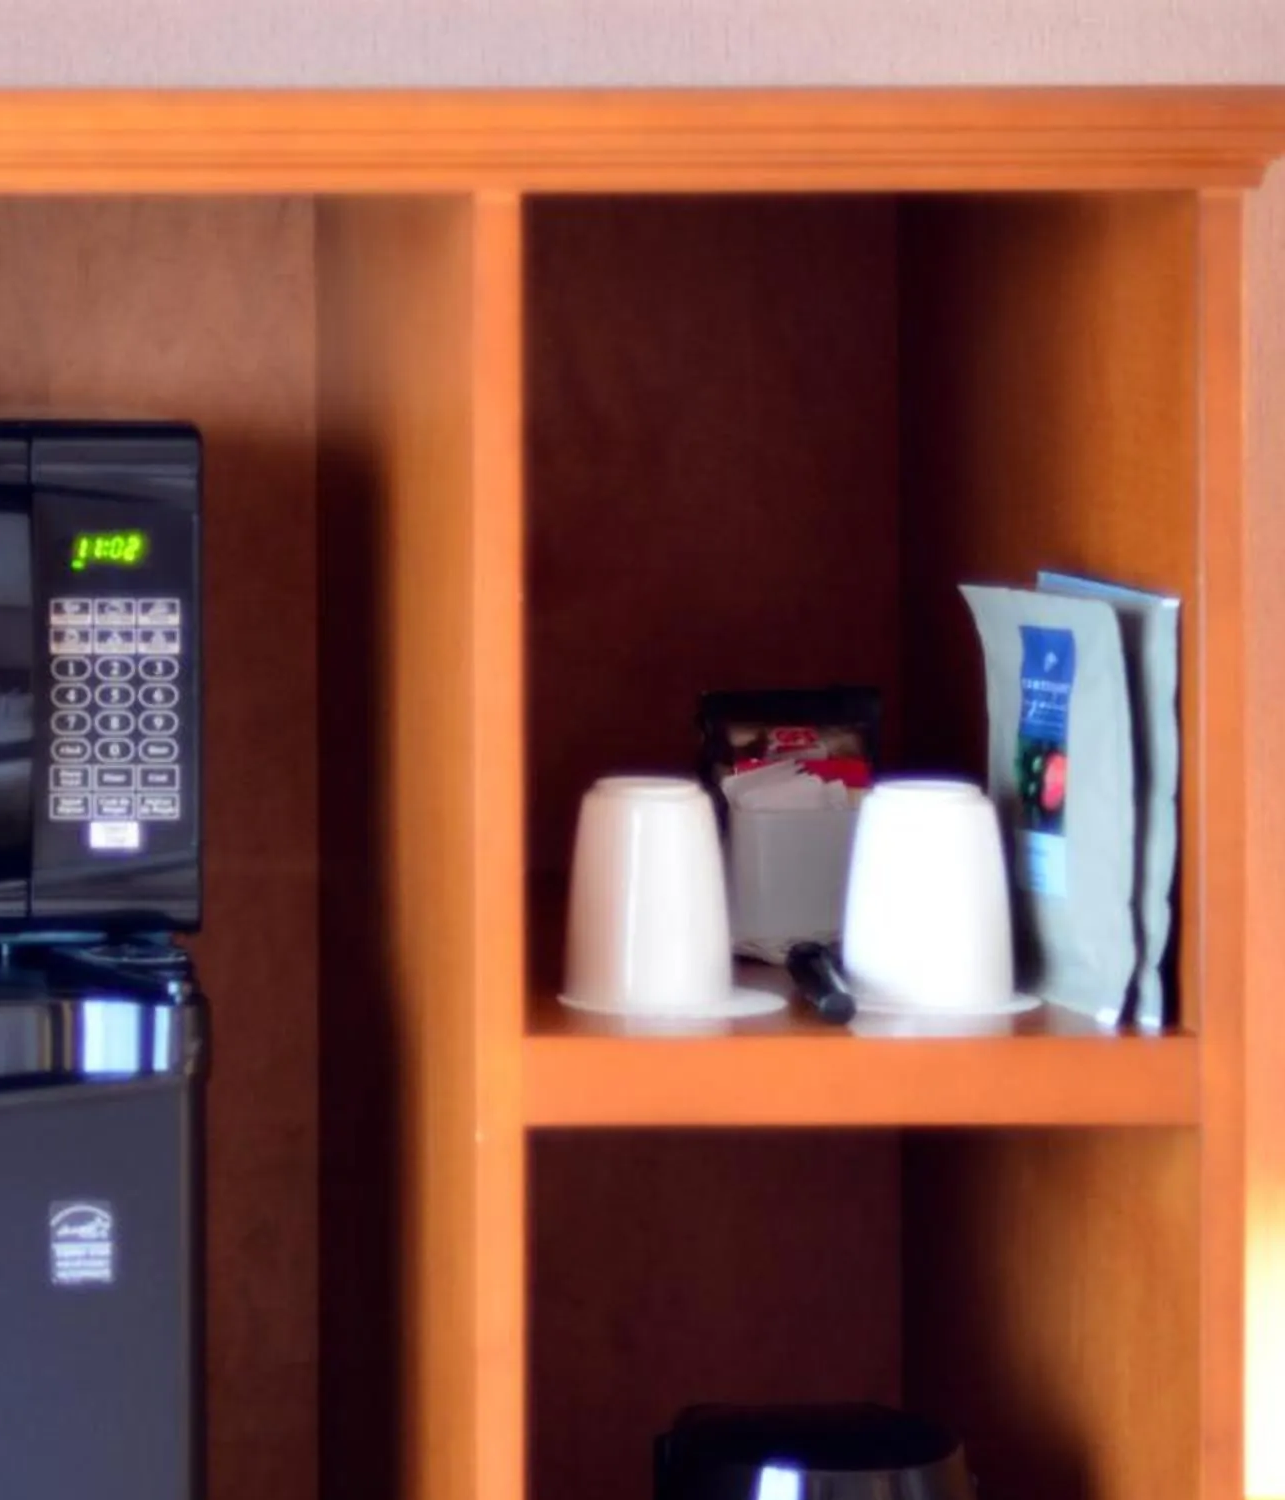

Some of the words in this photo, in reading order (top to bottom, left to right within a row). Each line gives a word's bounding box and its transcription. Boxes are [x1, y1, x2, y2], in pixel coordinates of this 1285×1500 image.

[110, 660, 120, 676] 2
[66, 687, 77, 703] 4
[66, 714, 76, 730] 7
[153, 714, 164, 730] 9
